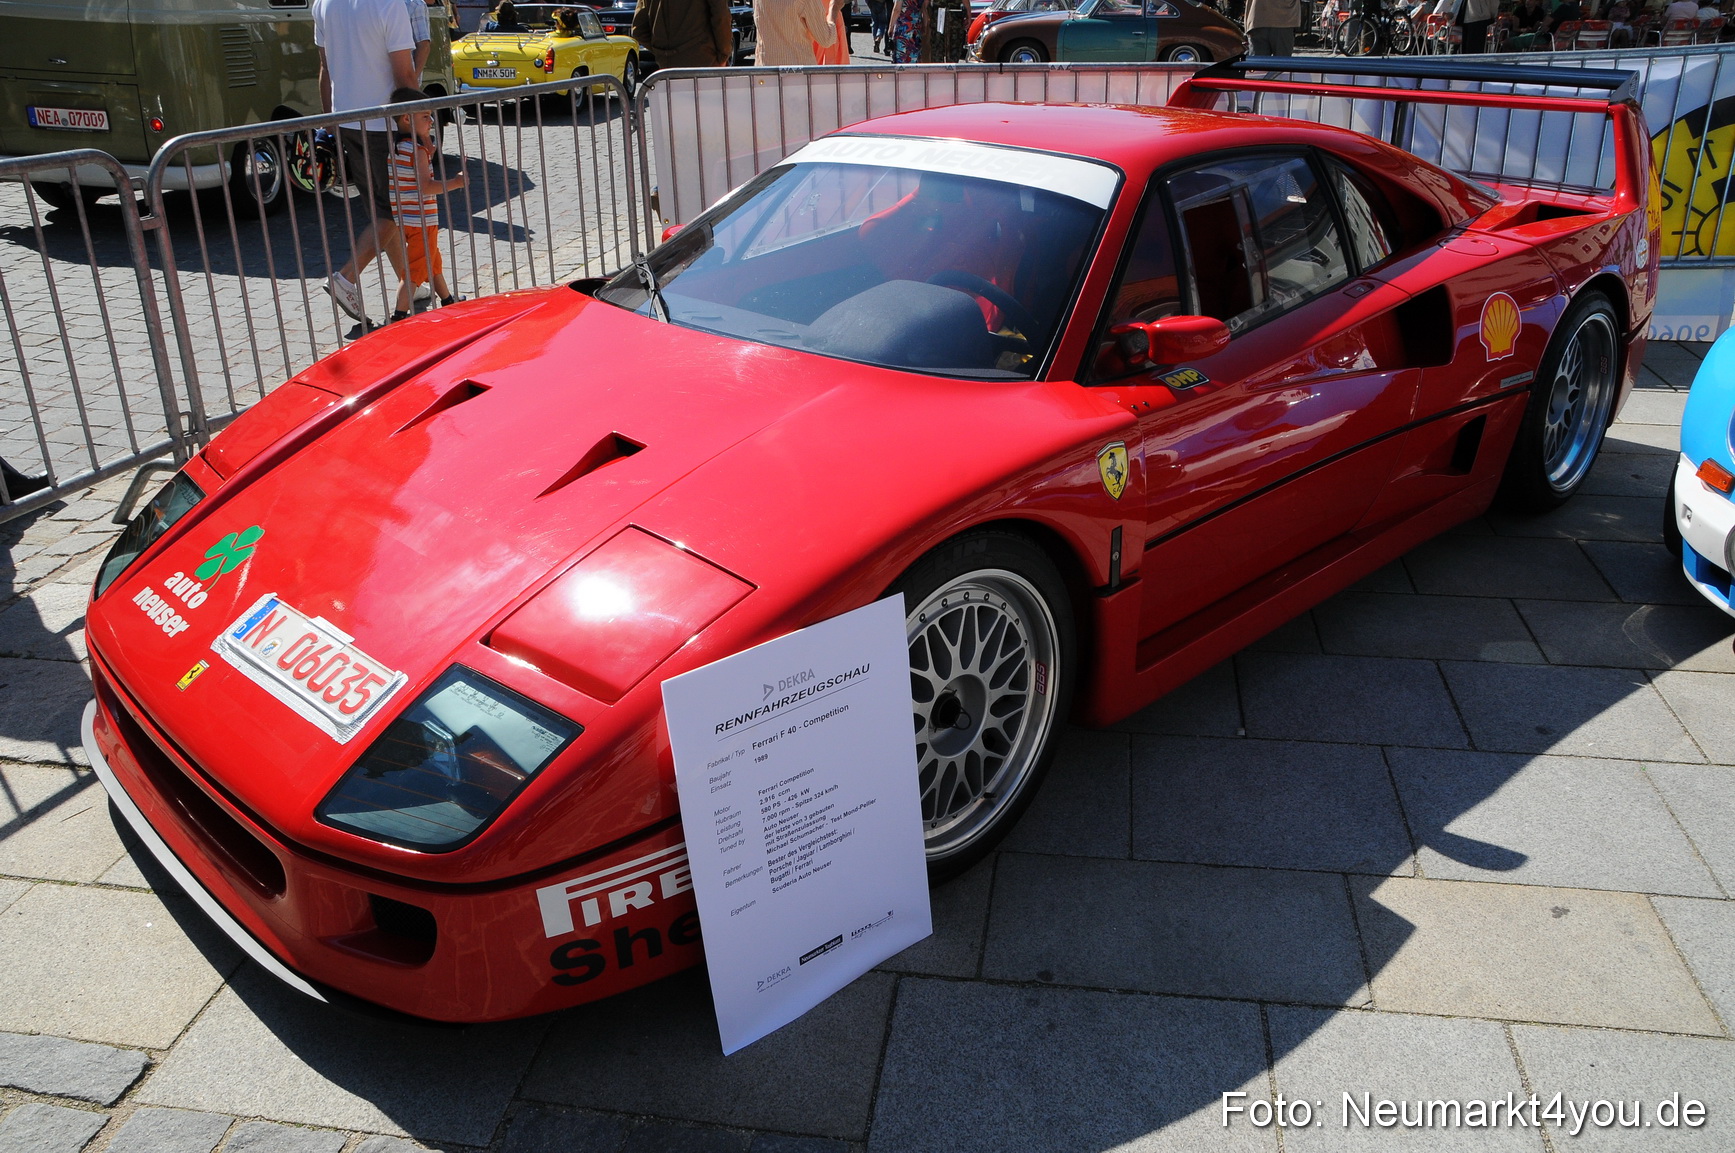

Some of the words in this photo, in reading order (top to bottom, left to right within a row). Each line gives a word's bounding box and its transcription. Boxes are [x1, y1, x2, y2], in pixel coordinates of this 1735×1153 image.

[478, 69, 488, 77] NM
[493, 69, 498, 77] K
[37, 109, 61, 125] NEA
[68, 111, 105, 127] 07009
[812, 142, 906, 159] AUTO
[1165, 369, 1199, 387] OMP
[163, 570, 208, 609] auto
[132, 586, 190, 638] neuser
[236, 623, 247, 634] D
[243, 609, 288, 648] N
[276, 632, 387, 715] 06035
[778, 668, 815, 692] DEKRA
[1035, 663, 1046, 695] BBS
[715, 663, 870, 734] RENNFAHRZEUGSCHAU
[707, 754, 730, 770] Fabrikat
[735, 748, 746, 759] Typ
[752, 733, 779, 750] Ferrari
[780, 730, 786, 739] F
[787, 726, 797, 736] 40
[803, 704, 849, 728] Competition
[709, 769, 732, 785] Baujahr
[754, 753, 769, 764] 1989
[710, 780, 732, 794] Einsatz
[714, 805, 731, 817] Motor
[758, 783, 778, 796] Ferrari
[779, 767, 815, 787] Competition
[715, 810, 742, 826] Hubraum
[778, 788, 791, 797] ccm
[717, 820, 741, 835] Leistung
[760, 805, 771, 815] 580
[772, 801, 781, 809] PS
[800, 788, 811, 796] kW
[718, 828, 743, 844] Drehzahl
[762, 812, 778, 824] 7.000
[778, 807, 791, 816] rpm
[795, 796, 813, 809] Spitze
[814, 790, 824, 800] 324
[824, 784, 839, 795] km/h
[764, 831, 774, 840] der
[775, 824, 791, 834] letzte
[792, 818, 803, 827] von
[809, 803, 835, 820] gebauten
[720, 841, 738, 854] Tuned
[738, 838, 746, 846] by
[763, 823, 777, 833] Auto
[778, 812, 799, 825] Neuser
[723, 864, 742, 876] Fahrer
[766, 841, 789, 855] Michael
[790, 823, 825, 843] Schumacher
[831, 814, 843, 824] Test
[765, 839, 775, 847] mit
[776, 815, 827, 842] Straßenzulassung
[725, 866, 763, 888] Bemerkungen
[767, 854, 786, 867] Bester
[787, 849, 798, 858] des
[769, 861, 792, 875] Porsche
[796, 849, 815, 862] Jaguar
[819, 829, 852, 851] Lamborghini
[770, 870, 790, 884] Bugatti
[794, 858, 814, 872] Ferrari
[730, 900, 756, 917] Eigentum
[772, 879, 797, 894] Scuderia
[798, 871, 812, 881] Auto
[813, 860, 832, 874] Neuser
[767, 966, 791, 983] DEKRA
